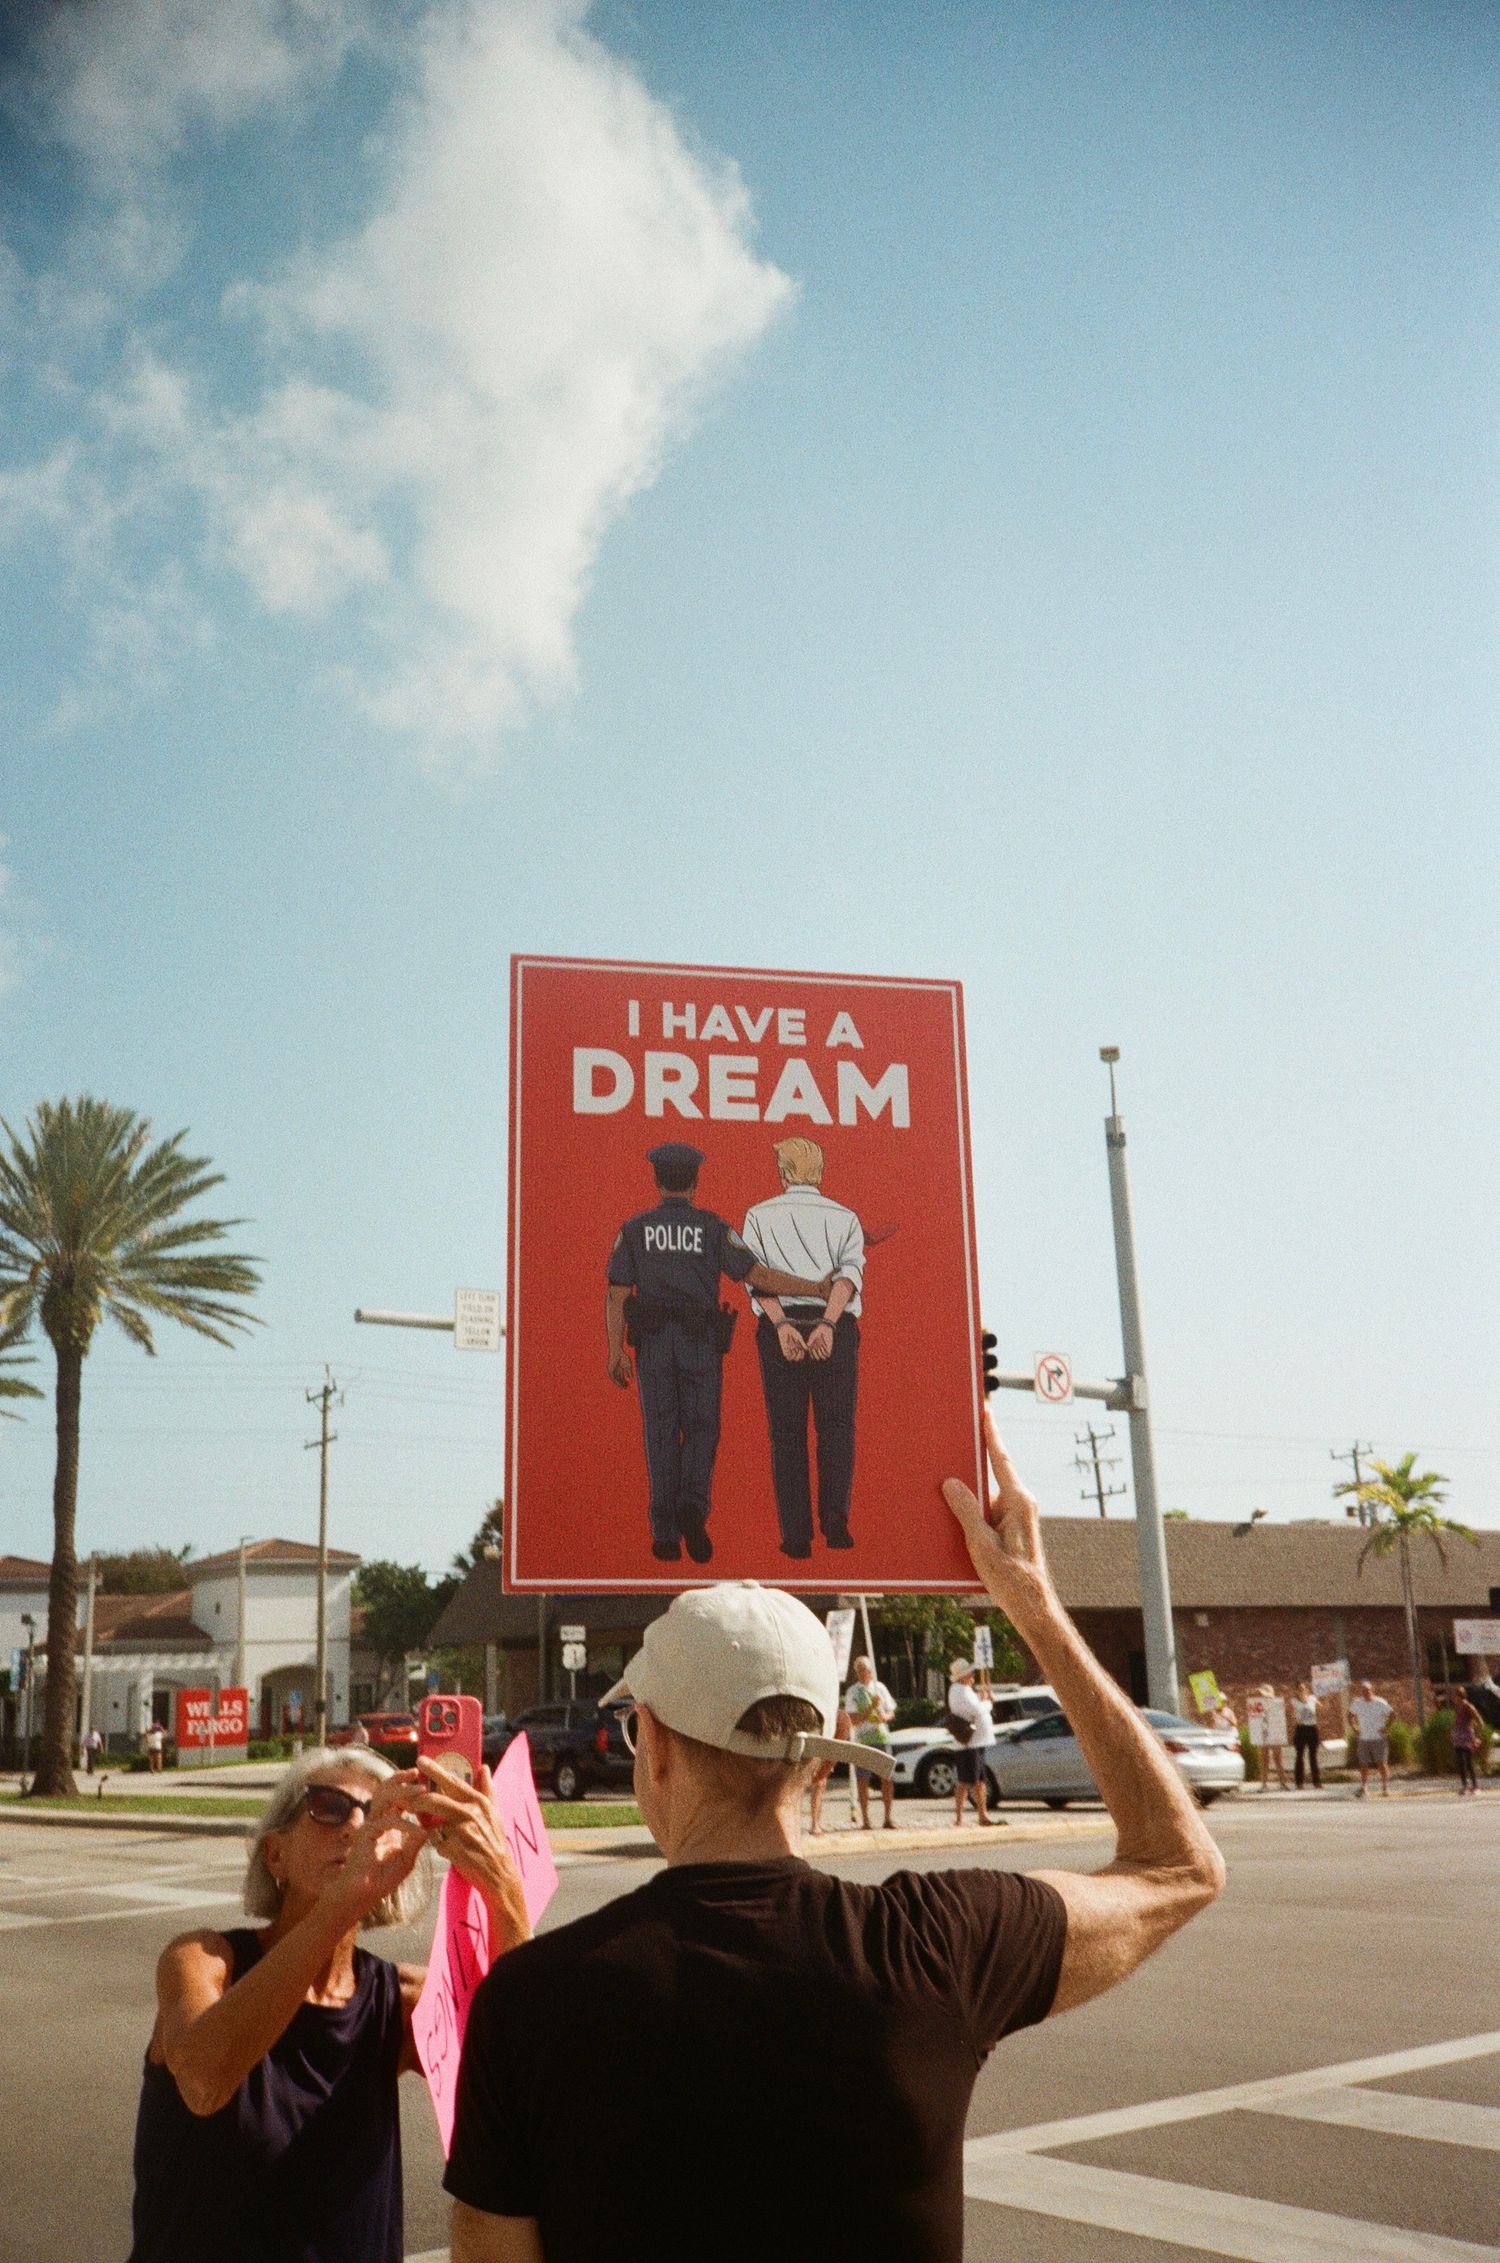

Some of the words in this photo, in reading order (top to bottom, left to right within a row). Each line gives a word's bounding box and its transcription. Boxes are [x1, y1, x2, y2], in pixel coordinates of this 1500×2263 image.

[628, 1000, 640, 1037] I
[663, 1002, 807, 1046] HAVE
[826, 1012, 865, 1049] A
[572, 1047, 911, 1129] DREAM
[644, 1225, 703, 1253] POLICE
[186, 1717, 243, 1735] FARGO
[426, 1898, 489, 2098] KINGS
